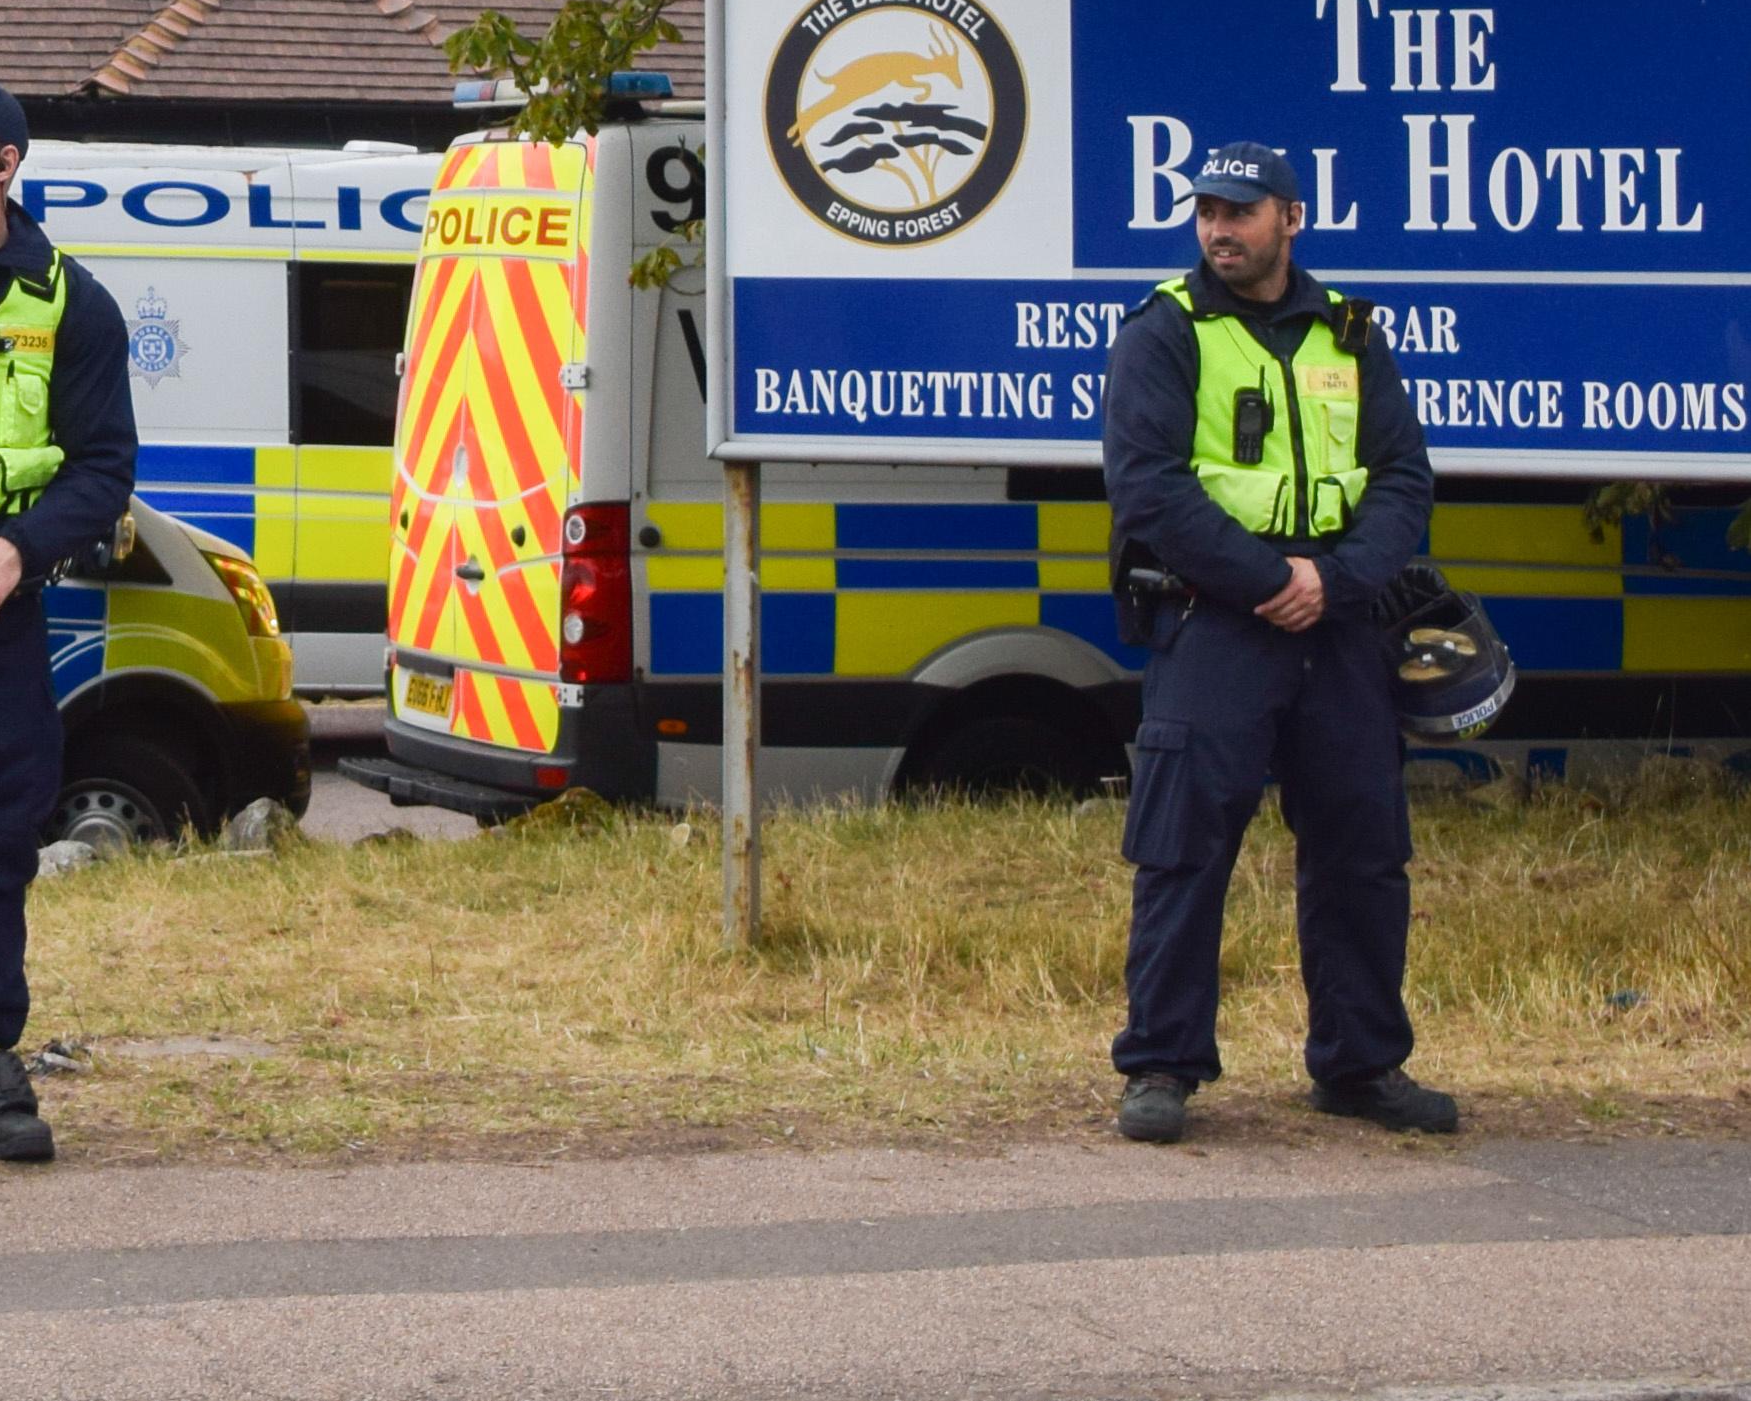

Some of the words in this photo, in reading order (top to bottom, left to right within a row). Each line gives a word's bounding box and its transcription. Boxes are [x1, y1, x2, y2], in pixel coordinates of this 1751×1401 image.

[1126, 115, 1358, 230] BL
[1402, 114, 1703, 233] HOTEL
[423, 206, 572, 247] POLICE
[826, 201, 890, 238] EPPING
[894, 202, 963, 238] FOREST
[755, 368, 1053, 423] BANQUETTING
[1401, 378, 1563, 429] RENCE
[1582, 381, 1748, 432] ROOMS
[1454, 699, 1495, 726] POLICE
